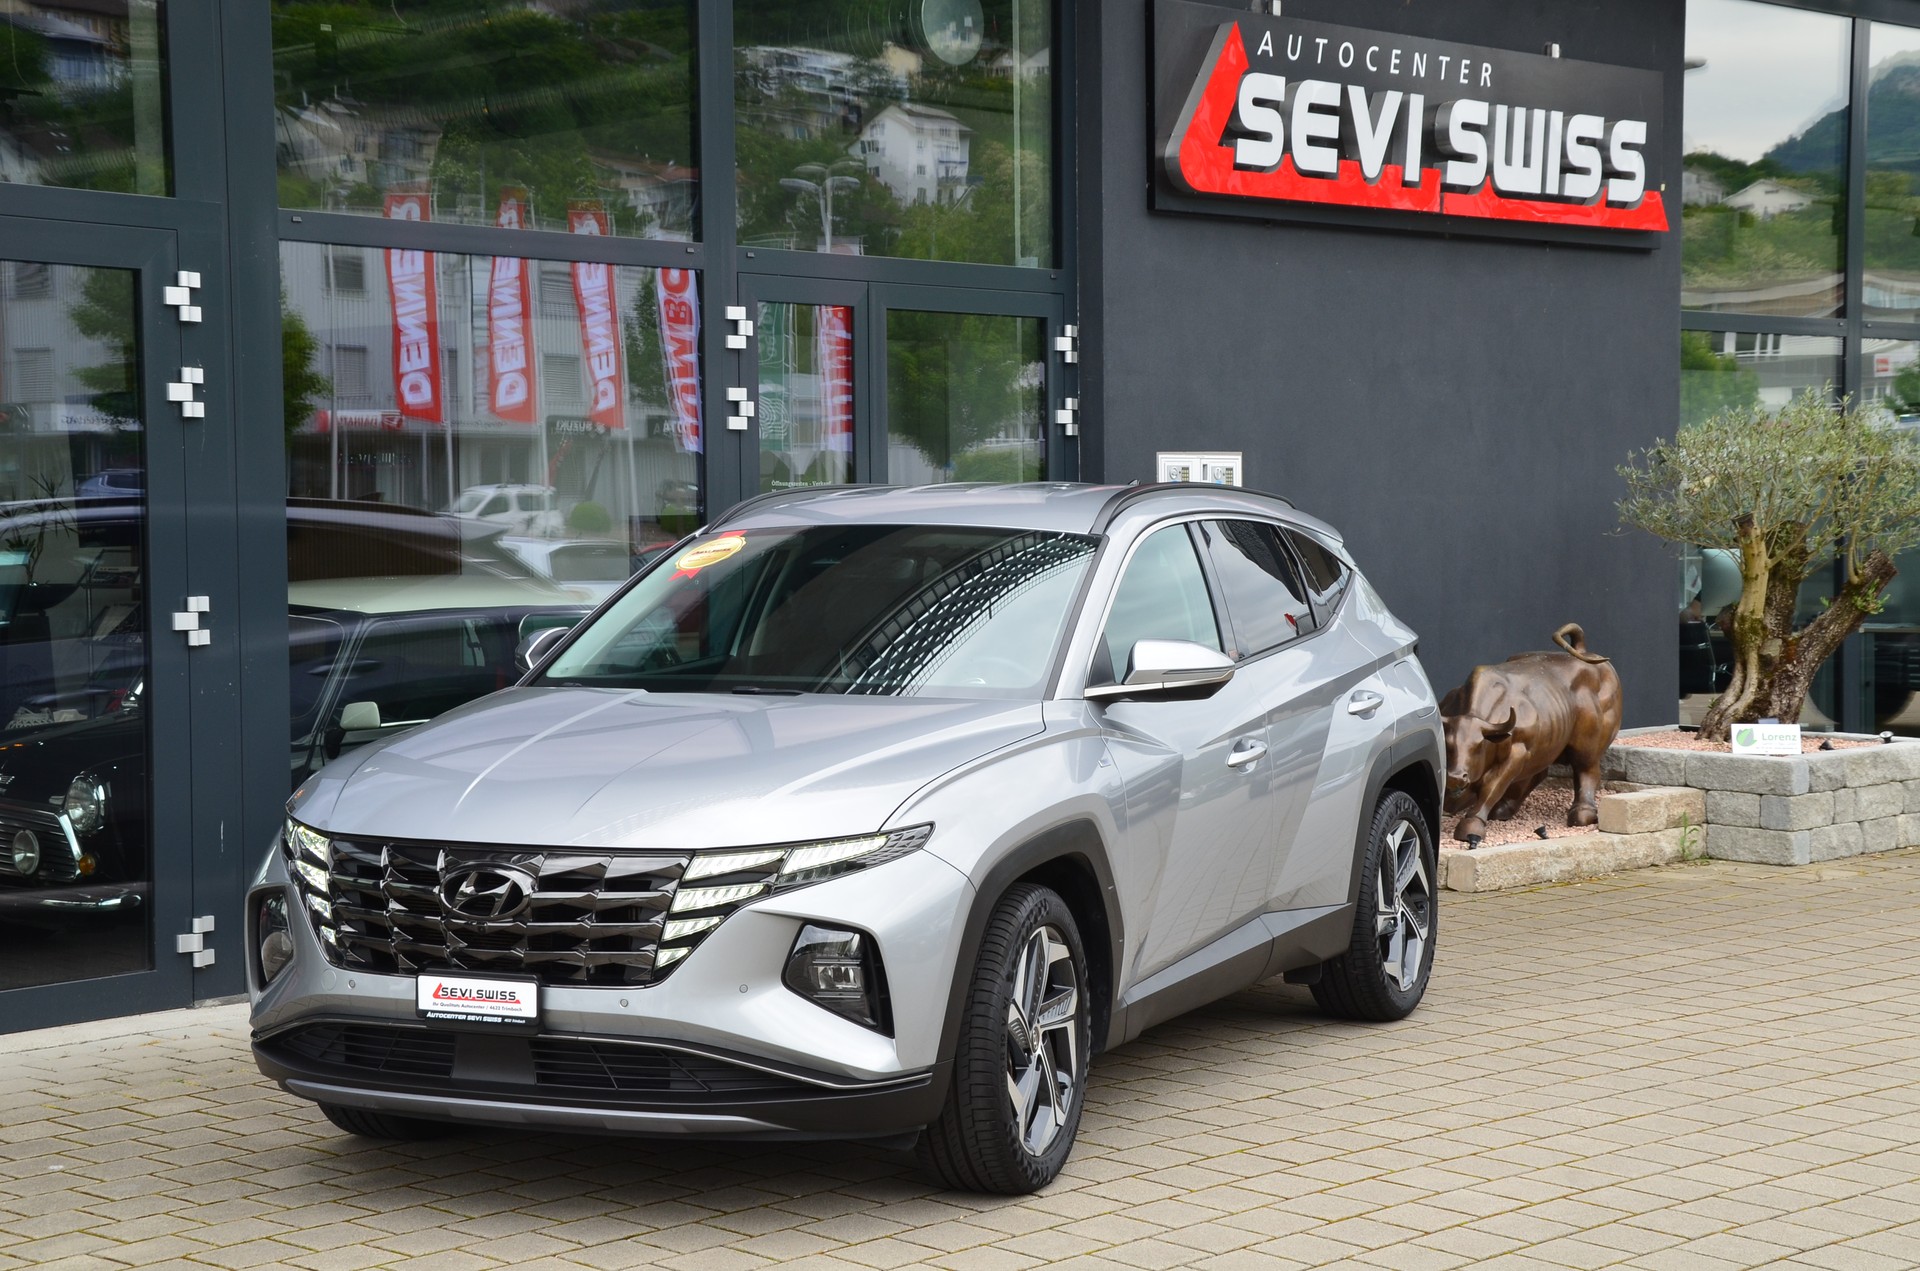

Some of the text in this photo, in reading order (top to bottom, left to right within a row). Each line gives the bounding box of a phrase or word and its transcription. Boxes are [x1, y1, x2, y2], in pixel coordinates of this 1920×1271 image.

[1256, 30, 1493, 88] AUTOCENTER
[1232, 71, 1648, 203] SEVI SWISS
[1762, 733, 1797, 741] Lorenz
[441, 986, 516, 1001] SEVI SWISS
